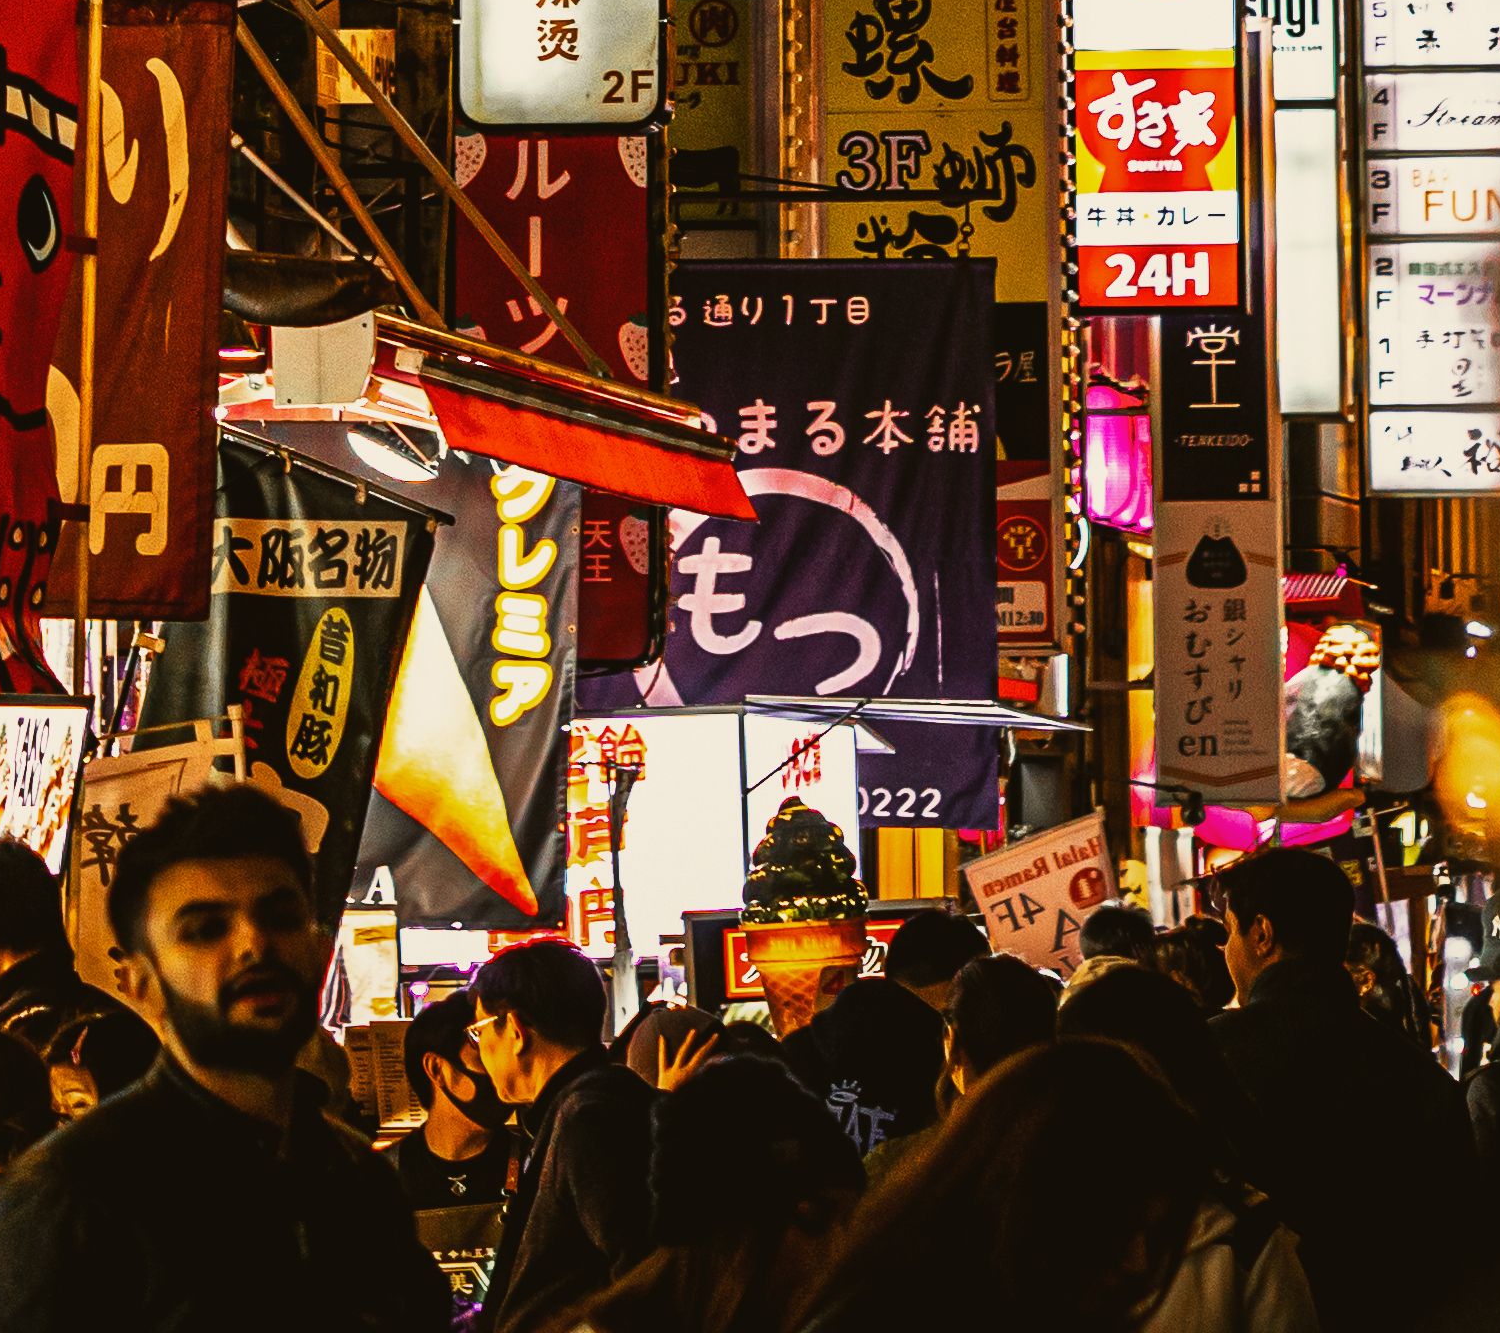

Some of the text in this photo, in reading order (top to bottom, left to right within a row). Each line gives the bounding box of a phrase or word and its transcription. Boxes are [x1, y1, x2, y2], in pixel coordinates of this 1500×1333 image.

[600, 69, 657, 106] 2F
[1087, 71, 1218, 155] すき家
[836, 128, 933, 194] 3F
[1085, 207, 1227, 228] 牛丼・カレー
[1104, 252, 1211, 300] 24H
[212, 522, 399, 590] 大阪名物
[490, 464, 558, 729] クレミア
[676, 535, 883, 695] もつ
[1183, 597, 1214, 727] おむすび
[1177, 730, 1219, 758] en
